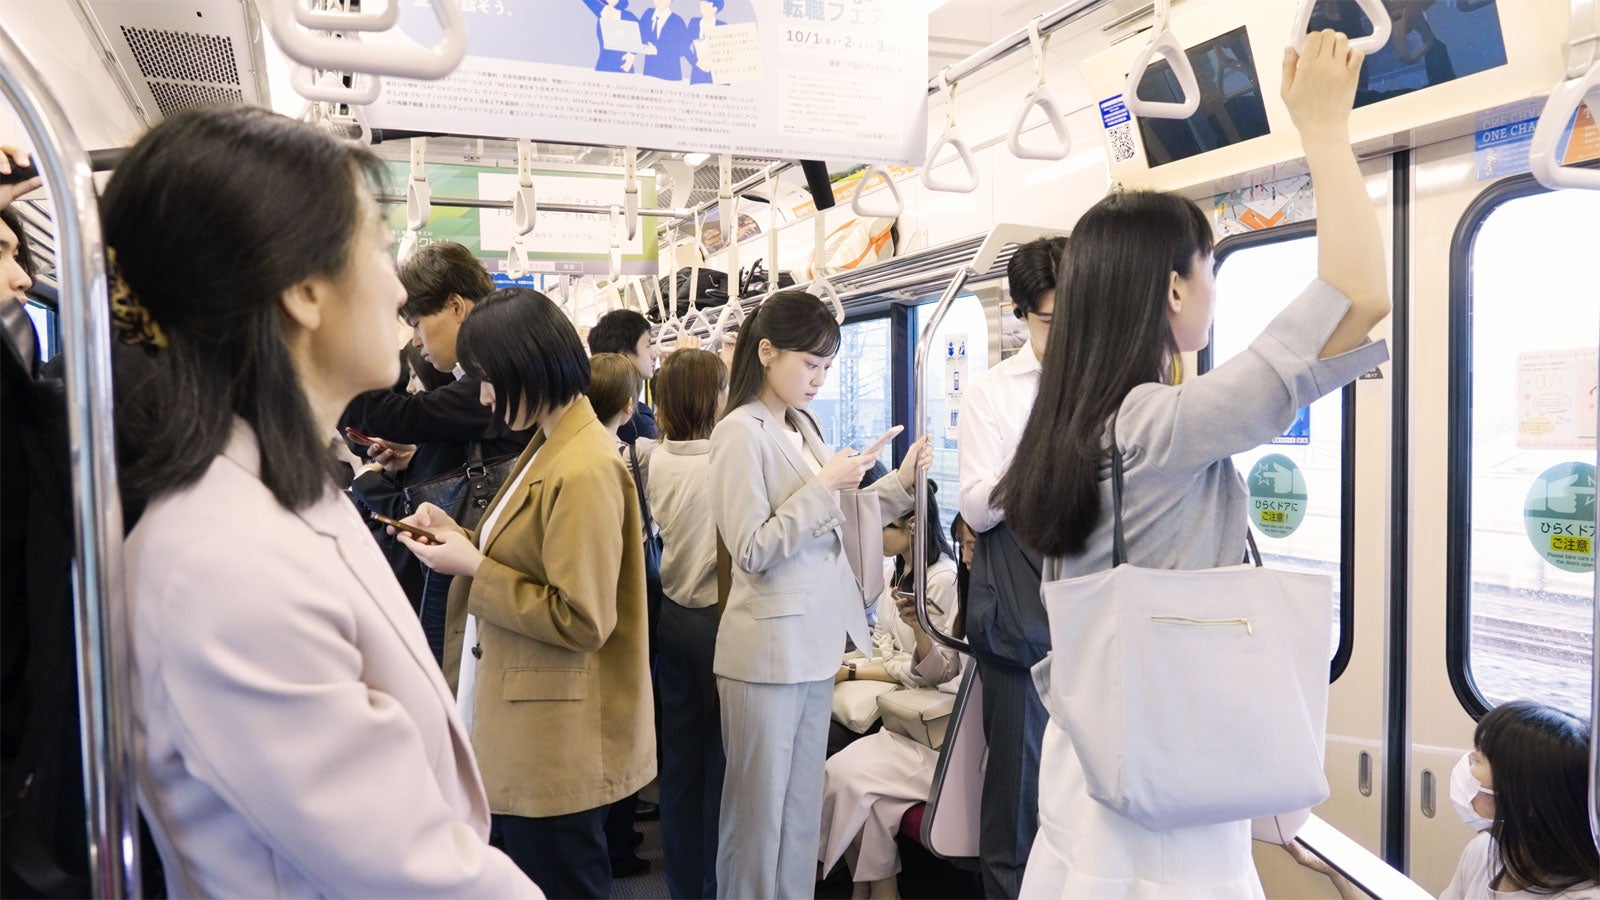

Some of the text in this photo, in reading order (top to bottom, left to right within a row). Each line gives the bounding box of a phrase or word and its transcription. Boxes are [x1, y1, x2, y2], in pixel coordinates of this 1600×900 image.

[782, 0, 886, 26] 転職フェア
[1482, 128, 1507, 143] ONE
[1255, 500, 1299, 512] ひらくドアに
[1552, 538, 1588, 552] ご注意
